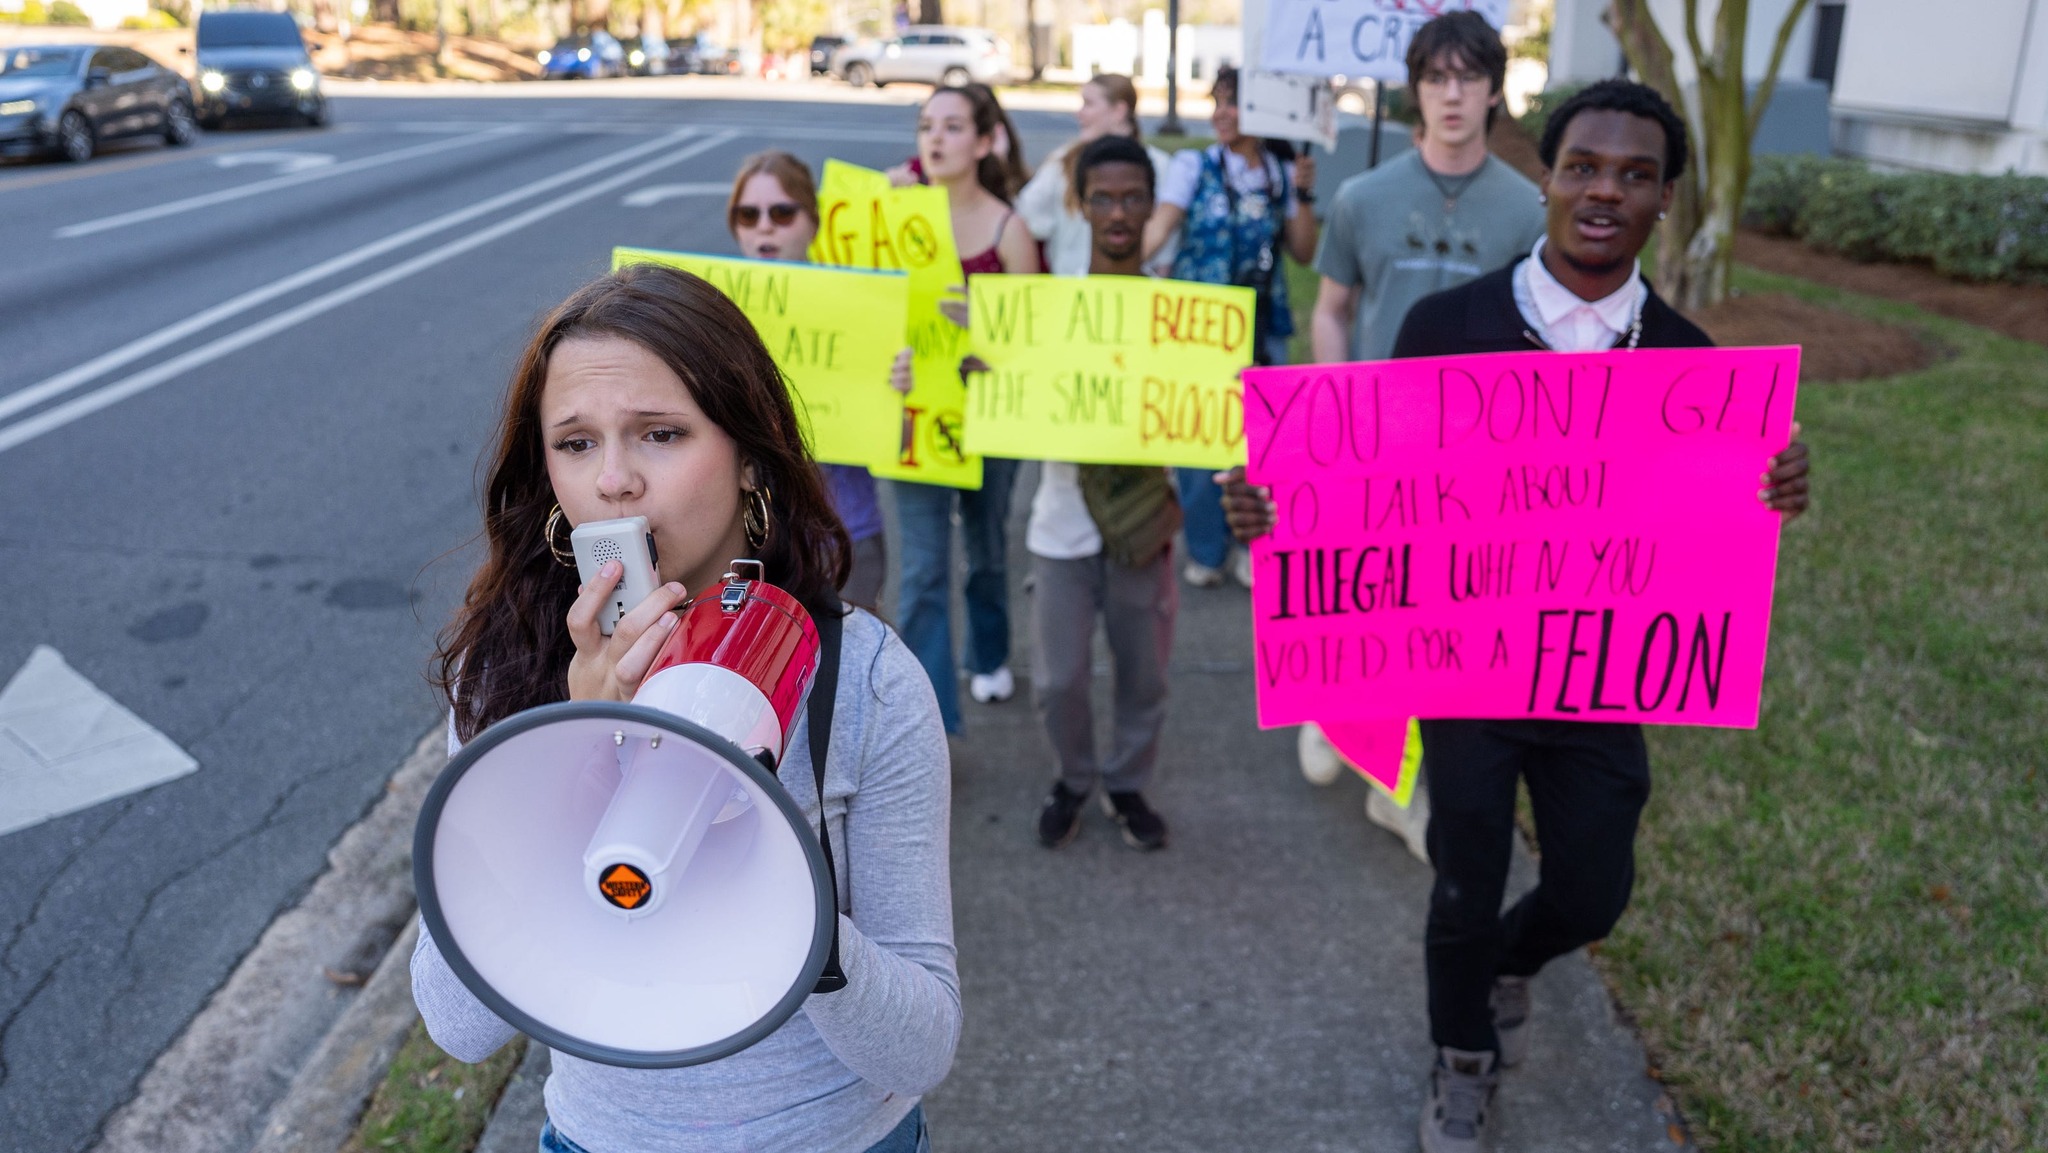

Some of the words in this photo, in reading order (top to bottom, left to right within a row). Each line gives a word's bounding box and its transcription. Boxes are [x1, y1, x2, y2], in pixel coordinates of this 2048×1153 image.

[1297, 6, 1325, 61] A
[975, 284, 1044, 345] WE
[1066, 289, 1131, 345] ALL
[1151, 292, 1246, 352] BLEED
[1051, 370, 1126, 425] SAME
[1140, 376, 1245, 448] BLOOD
[1251, 374, 1381, 471] YOU
[1437, 364, 1622, 449] DON'T
[1354, 473, 1471, 532] TALK
[1499, 460, 1609, 515] ABOUT
[1449, 540, 1571, 602] WHEN
[1586, 537, 1657, 597] YOU
[1260, 632, 1389, 688] VOTED
[1406, 627, 1464, 672] FOR
[1487, 628, 1509, 670] A
[1526, 608, 1732, 714] FELON
